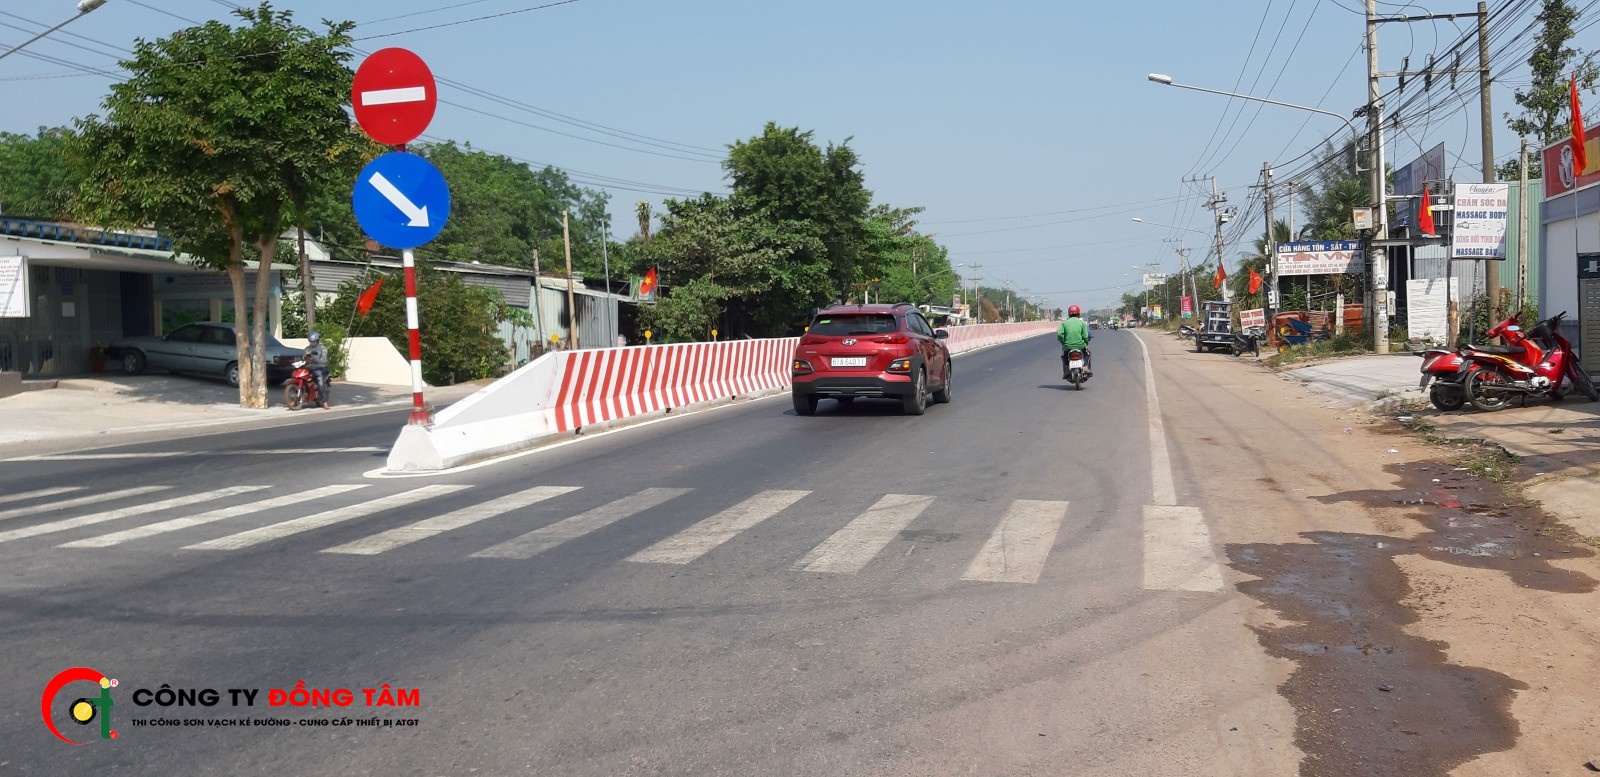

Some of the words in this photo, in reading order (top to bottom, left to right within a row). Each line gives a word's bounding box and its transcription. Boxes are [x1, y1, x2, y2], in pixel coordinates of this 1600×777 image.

[1497, 198, 1507, 207] DA
[1456, 211, 1487, 219] MASSAGE
[1489, 211, 1507, 219] BODY
[1278, 244, 1292, 253] CỬA
[1293, 244, 1311, 252] HÀNG
[1312, 243, 1325, 251] TÔN
[1330, 241, 1343, 251] SẮT
[1455, 248, 1484, 256] MASSAGE
